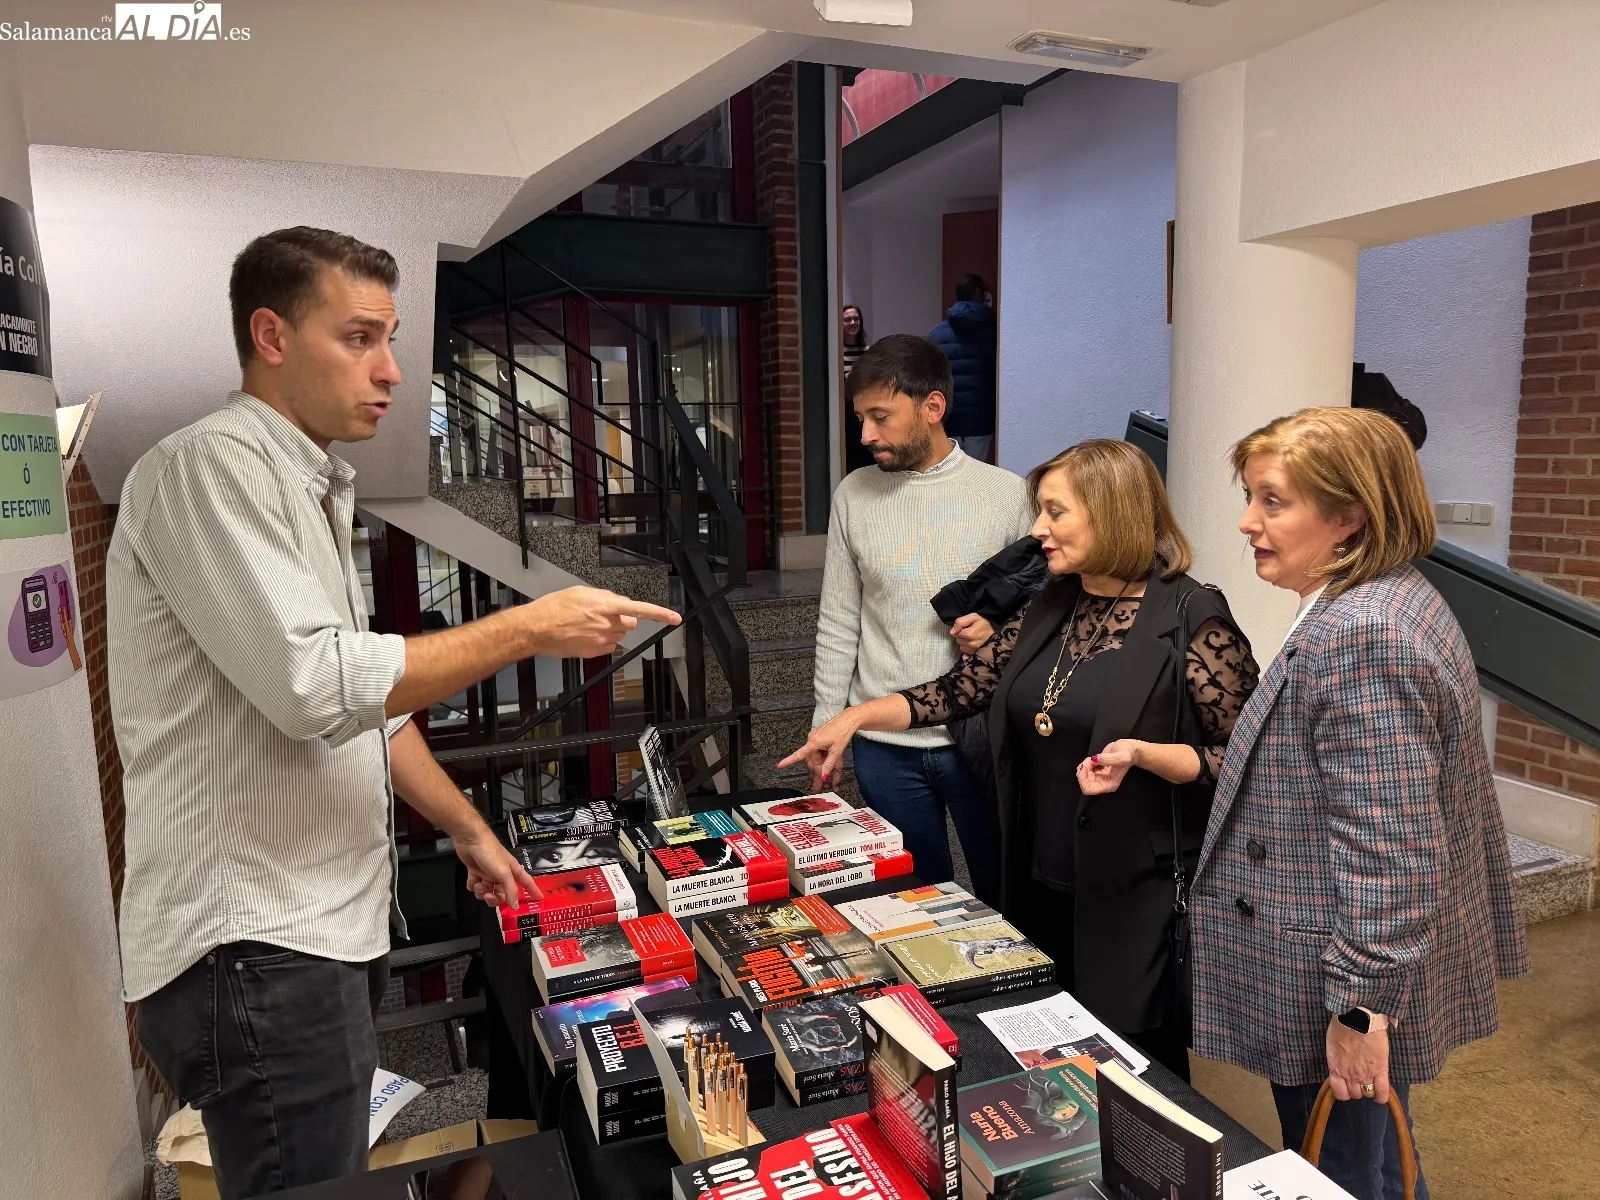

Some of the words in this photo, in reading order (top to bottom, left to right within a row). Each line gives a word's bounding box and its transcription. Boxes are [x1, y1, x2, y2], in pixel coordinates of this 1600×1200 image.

[9, 332, 38, 356] NEGRO
[2, 434, 26, 452] CON
[27, 435, 59, 453] TARJETA
[23, 462, 31, 484] Ó
[2, 499, 51, 518] EFECTIVO
[798, 856, 807, 865] EL
[828, 847, 857, 859] VERDUGO
[859, 843, 873, 852] TONI
[874, 841, 886, 850] HILL
[672, 885, 681, 894] LA
[681, 880, 708, 892] MUERTE
[709, 875, 735, 887] BLANCA
[809, 882, 817, 890] LA
[817, 878, 835, 889] HORA
[835, 875, 847, 885] DEL
[847, 871, 863, 882] LOBO
[674, 904, 683, 913] LA
[683, 899, 710, 911] MUERTE
[711, 894, 737, 906] BLANCA
[591, 1024, 627, 1073] PROYECTO
[381, 1075, 410, 1096] PAGO
[970, 1111, 1001, 1142] Nuria
[982, 1105, 1019, 1141] Bueno
[999, 1100, 1035, 1135] Amazona
[943, 1124, 955, 1141] EL
[846, 1136, 863, 1156] PISANDO
[943, 1140, 957, 1169] HIJO
[869, 1170, 880, 1180] QUE
[870, 1160, 879, 1170] DEL
[769, 1160, 824, 1200] DEL
[876, 1169, 892, 1187] MUNDO
[876, 1180, 890, 1195] AUTOR
[945, 1170, 958, 1195] DEL
